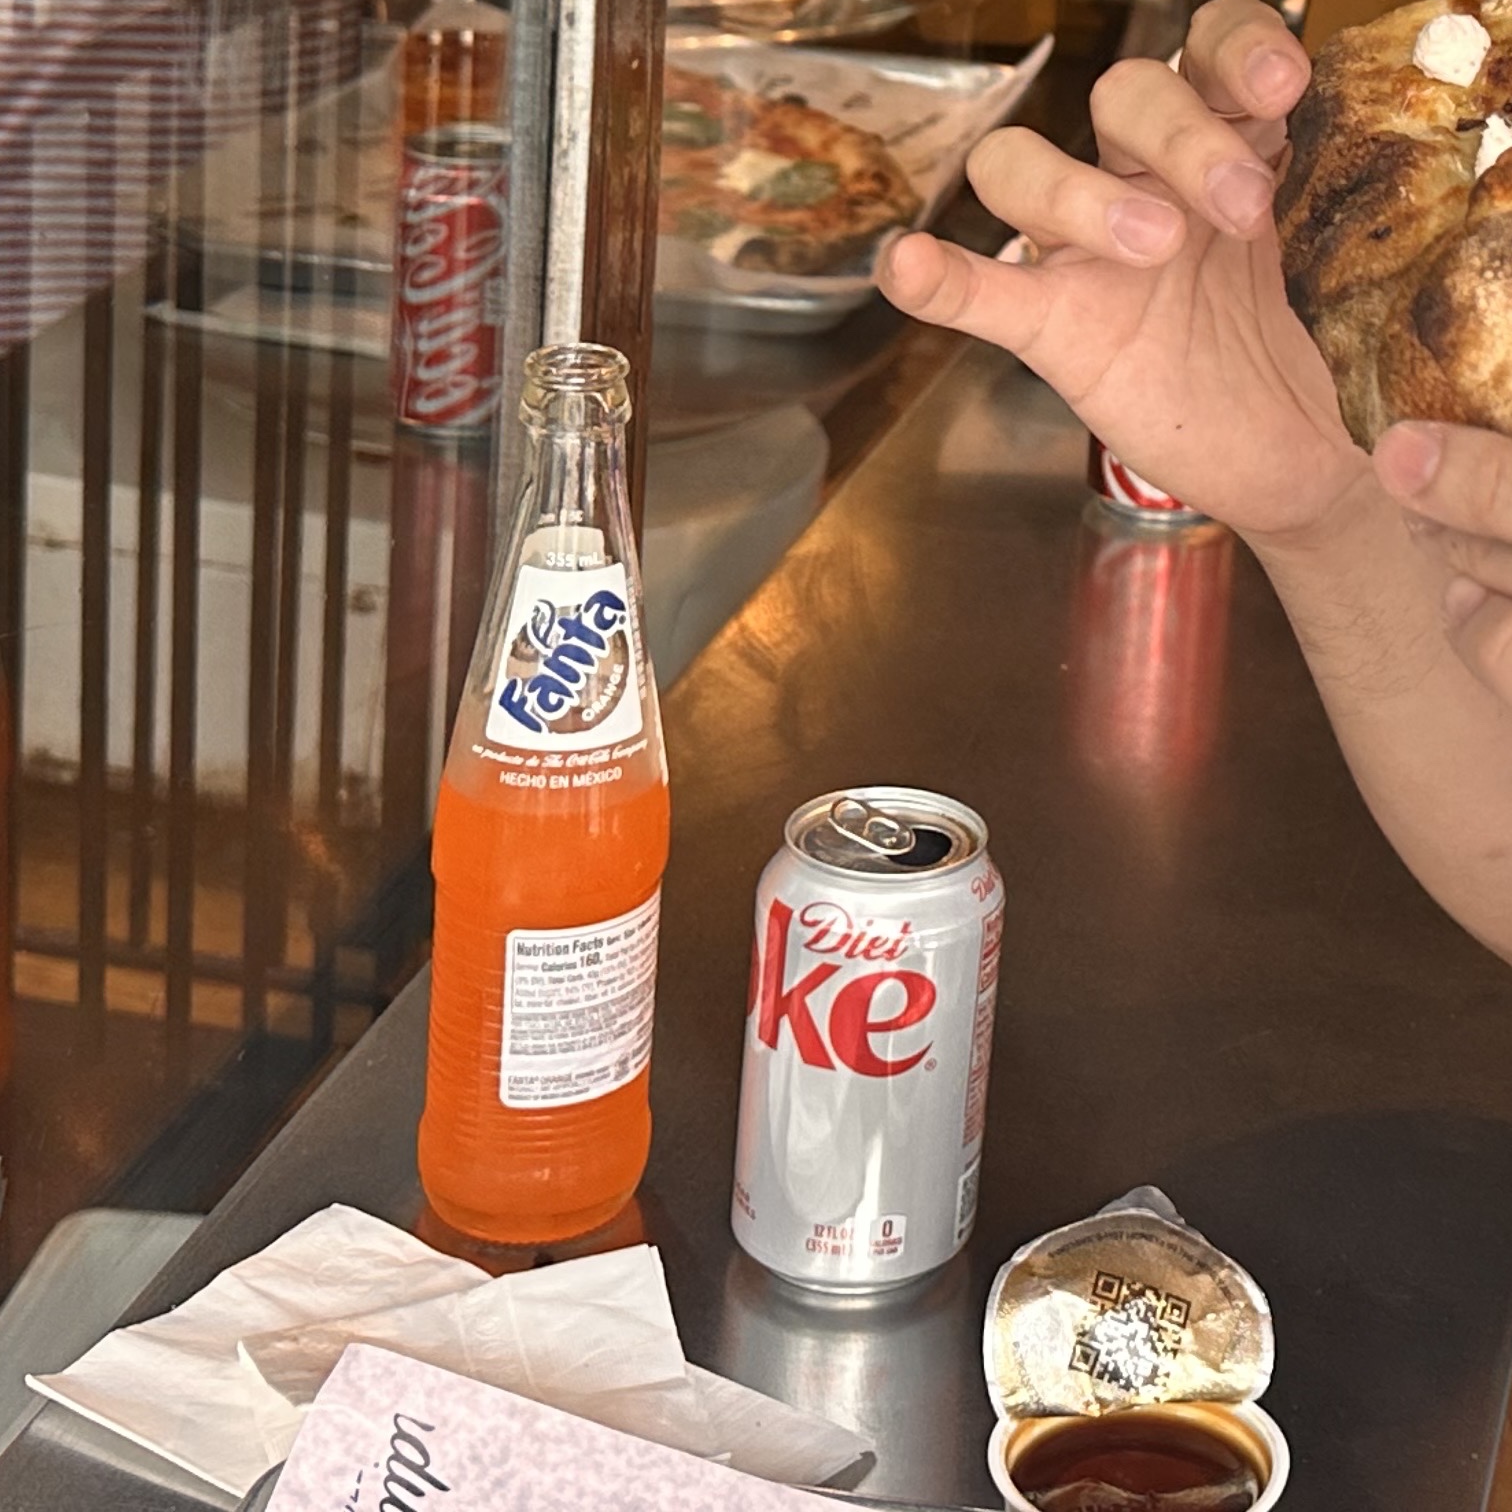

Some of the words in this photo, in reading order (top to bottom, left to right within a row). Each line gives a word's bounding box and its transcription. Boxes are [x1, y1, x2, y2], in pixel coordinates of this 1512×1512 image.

[498, 589, 627, 734] Fanta
[581, 663, 626, 723] ORANGE
[499, 769, 547, 790] HECHO
[549, 772, 571, 790] EN
[517, 941, 570, 957] Nutrition
[572, 936, 604, 954] Facts
[800, 901, 912, 962] Diet
[746, 897, 937, 1079] ke
[883, 1220, 893, 1237] 0
